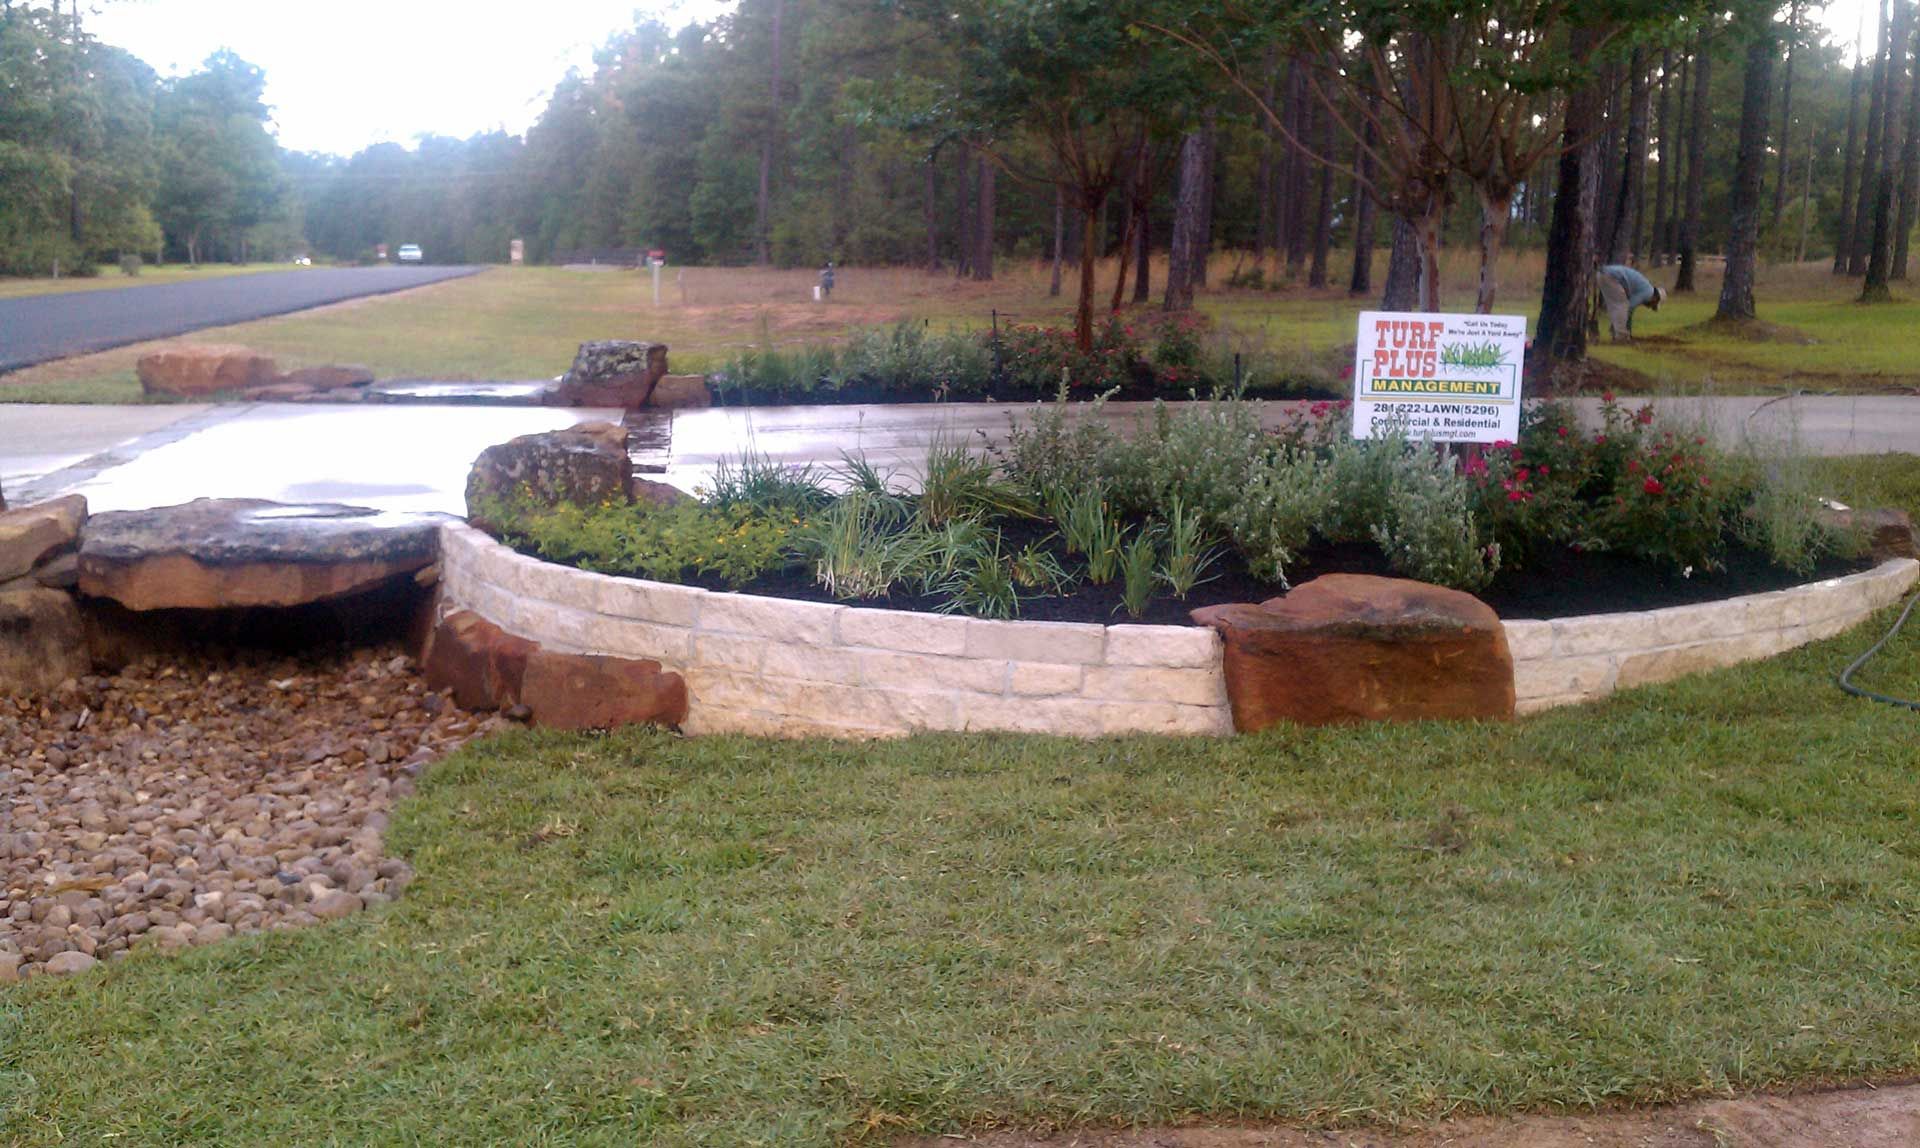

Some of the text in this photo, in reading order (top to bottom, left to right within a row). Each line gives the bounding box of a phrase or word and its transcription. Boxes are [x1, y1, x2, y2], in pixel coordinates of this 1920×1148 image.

[1375, 320, 1444, 349] TURF
[1372, 350, 1437, 378] PLUS
[1373, 380, 1500, 394] MANAGEMENT
[1373, 403, 1500, 417] 281222-LAWN(5296)
[1371, 416, 1501, 429] Comrcial & Residential
